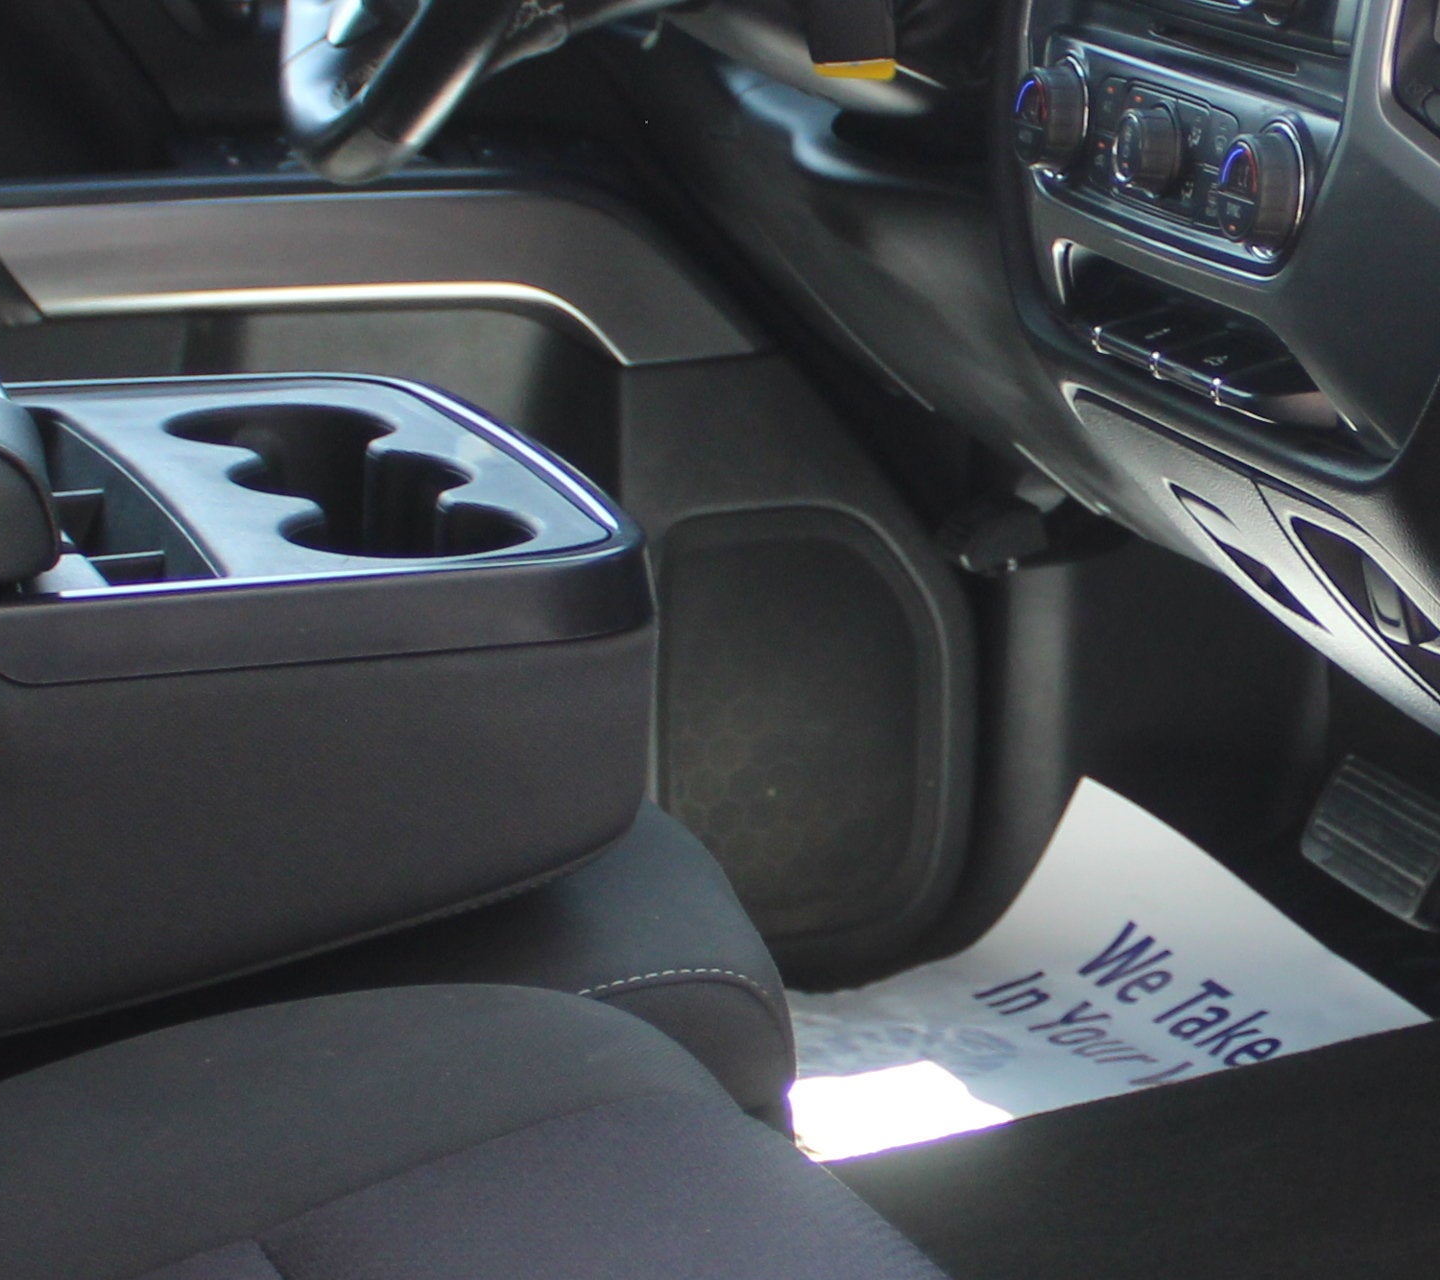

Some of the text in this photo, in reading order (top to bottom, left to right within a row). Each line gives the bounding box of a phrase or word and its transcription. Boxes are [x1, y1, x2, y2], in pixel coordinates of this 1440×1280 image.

[972, 970, 1158, 1065] In Your
[1078, 920, 1283, 1068] We Take
